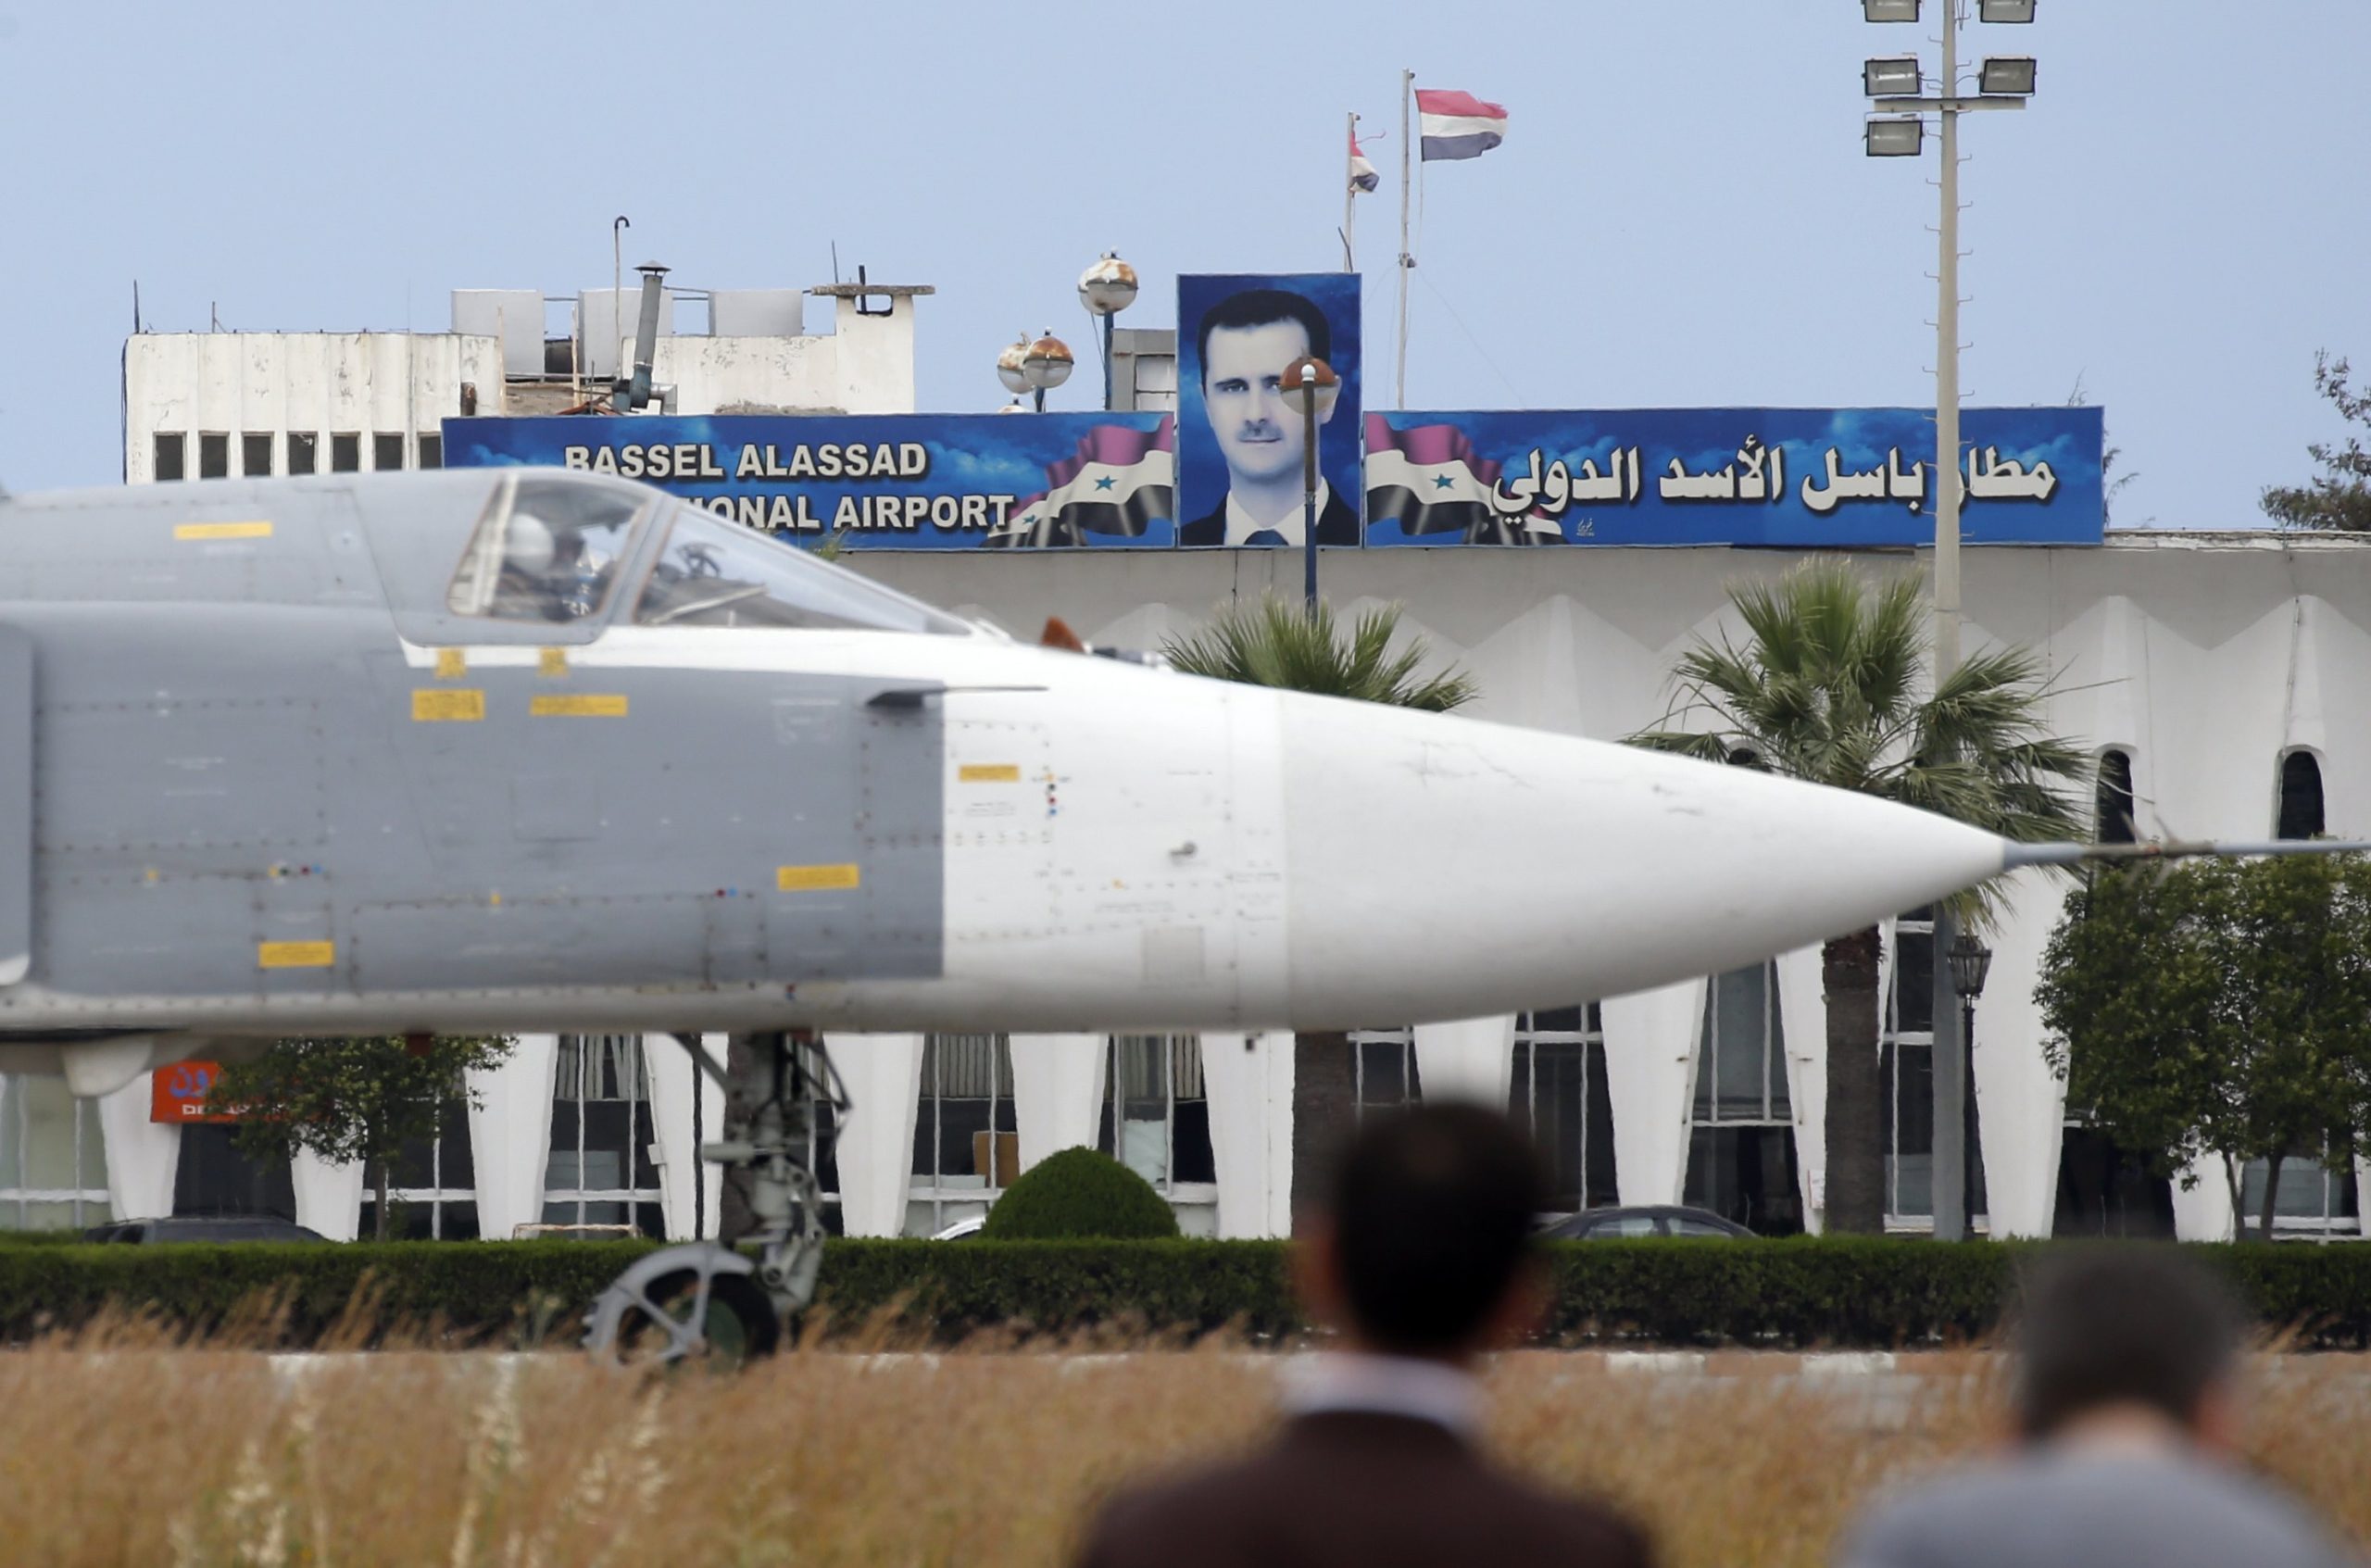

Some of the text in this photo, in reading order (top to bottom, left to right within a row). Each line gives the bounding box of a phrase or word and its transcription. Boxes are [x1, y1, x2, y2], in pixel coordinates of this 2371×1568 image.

[564, 443, 927, 477] BASSEL ALASSAD
[1491, 433, 2056, 525] مطا باسل الأسد الدولي
[833, 495, 1015, 529] AIRPORT
